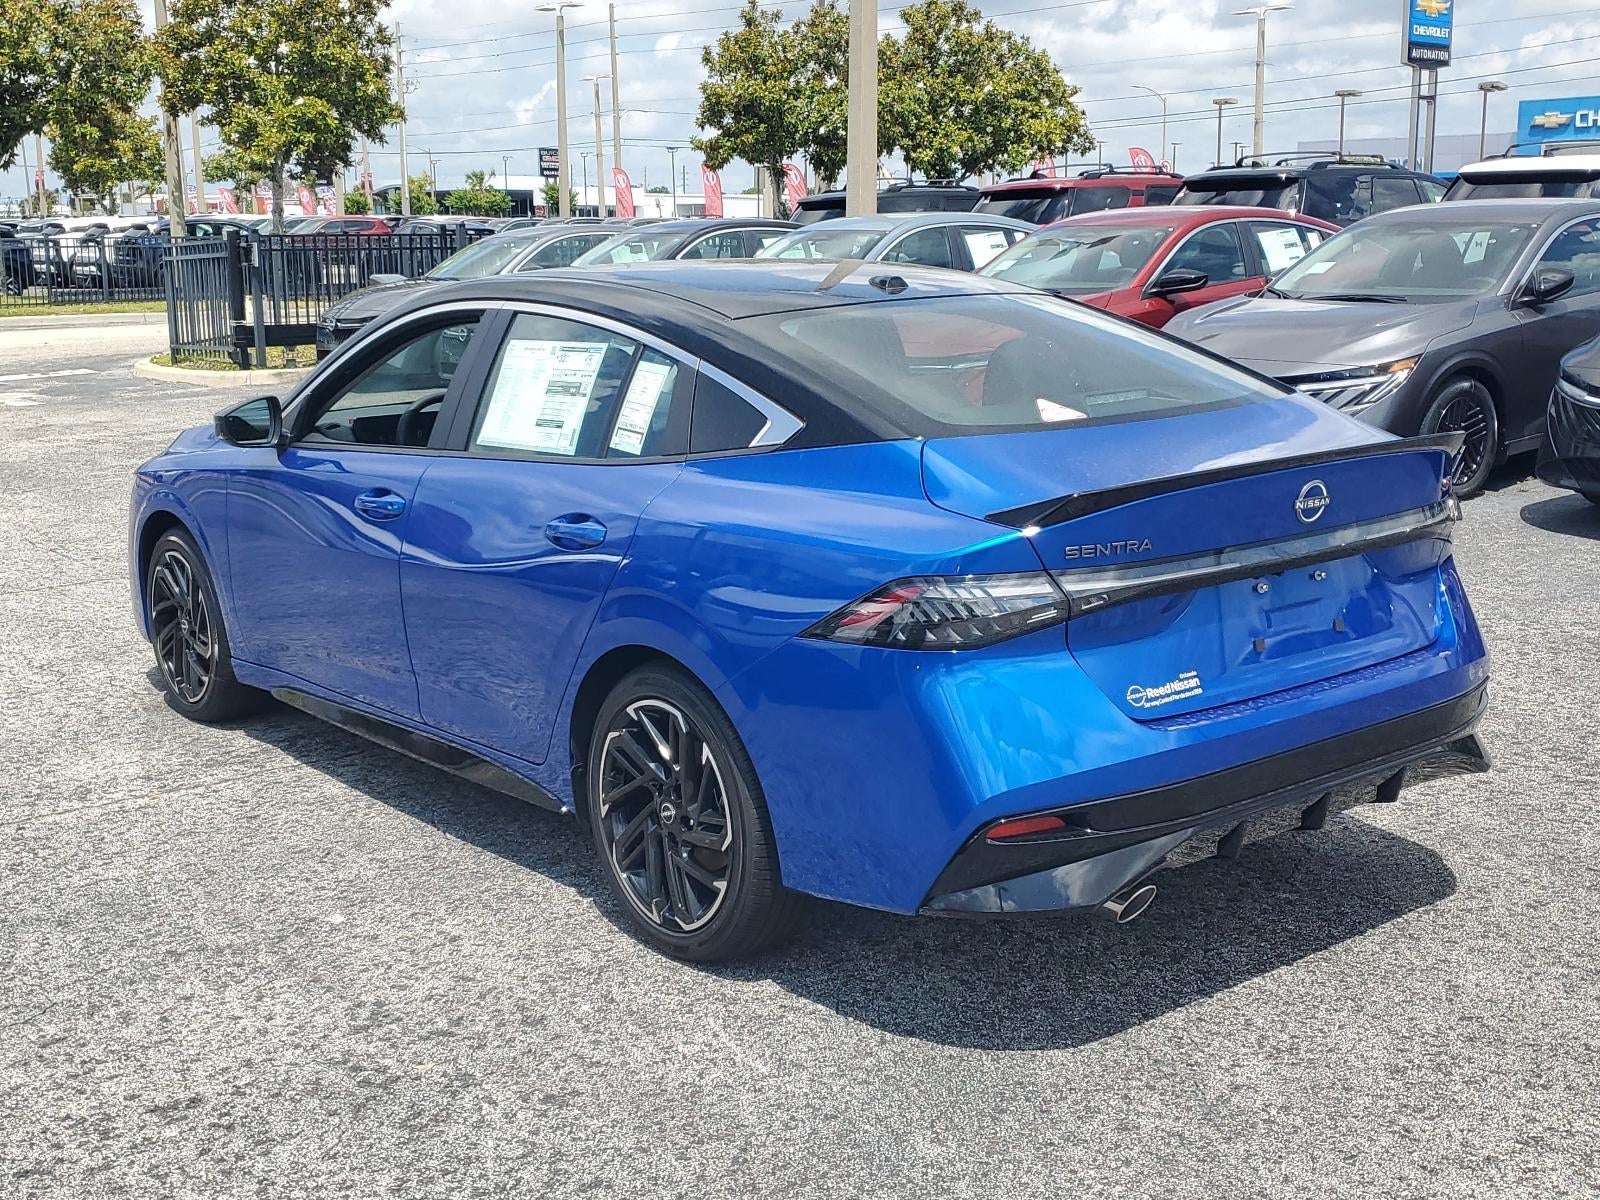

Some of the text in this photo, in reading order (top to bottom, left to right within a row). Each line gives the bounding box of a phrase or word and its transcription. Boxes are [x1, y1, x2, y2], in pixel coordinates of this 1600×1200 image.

[1413, 25, 1450, 37] CHEVROLET
[1411, 48, 1449, 60] AUTONATION
[1575, 110, 1600, 128] CH
[1296, 497, 1330, 509] NISSAN
[1065, 538, 1152, 560] SENTRA
[1146, 683, 1171, 698] Reed
[1170, 678, 1200, 692] Nissan
